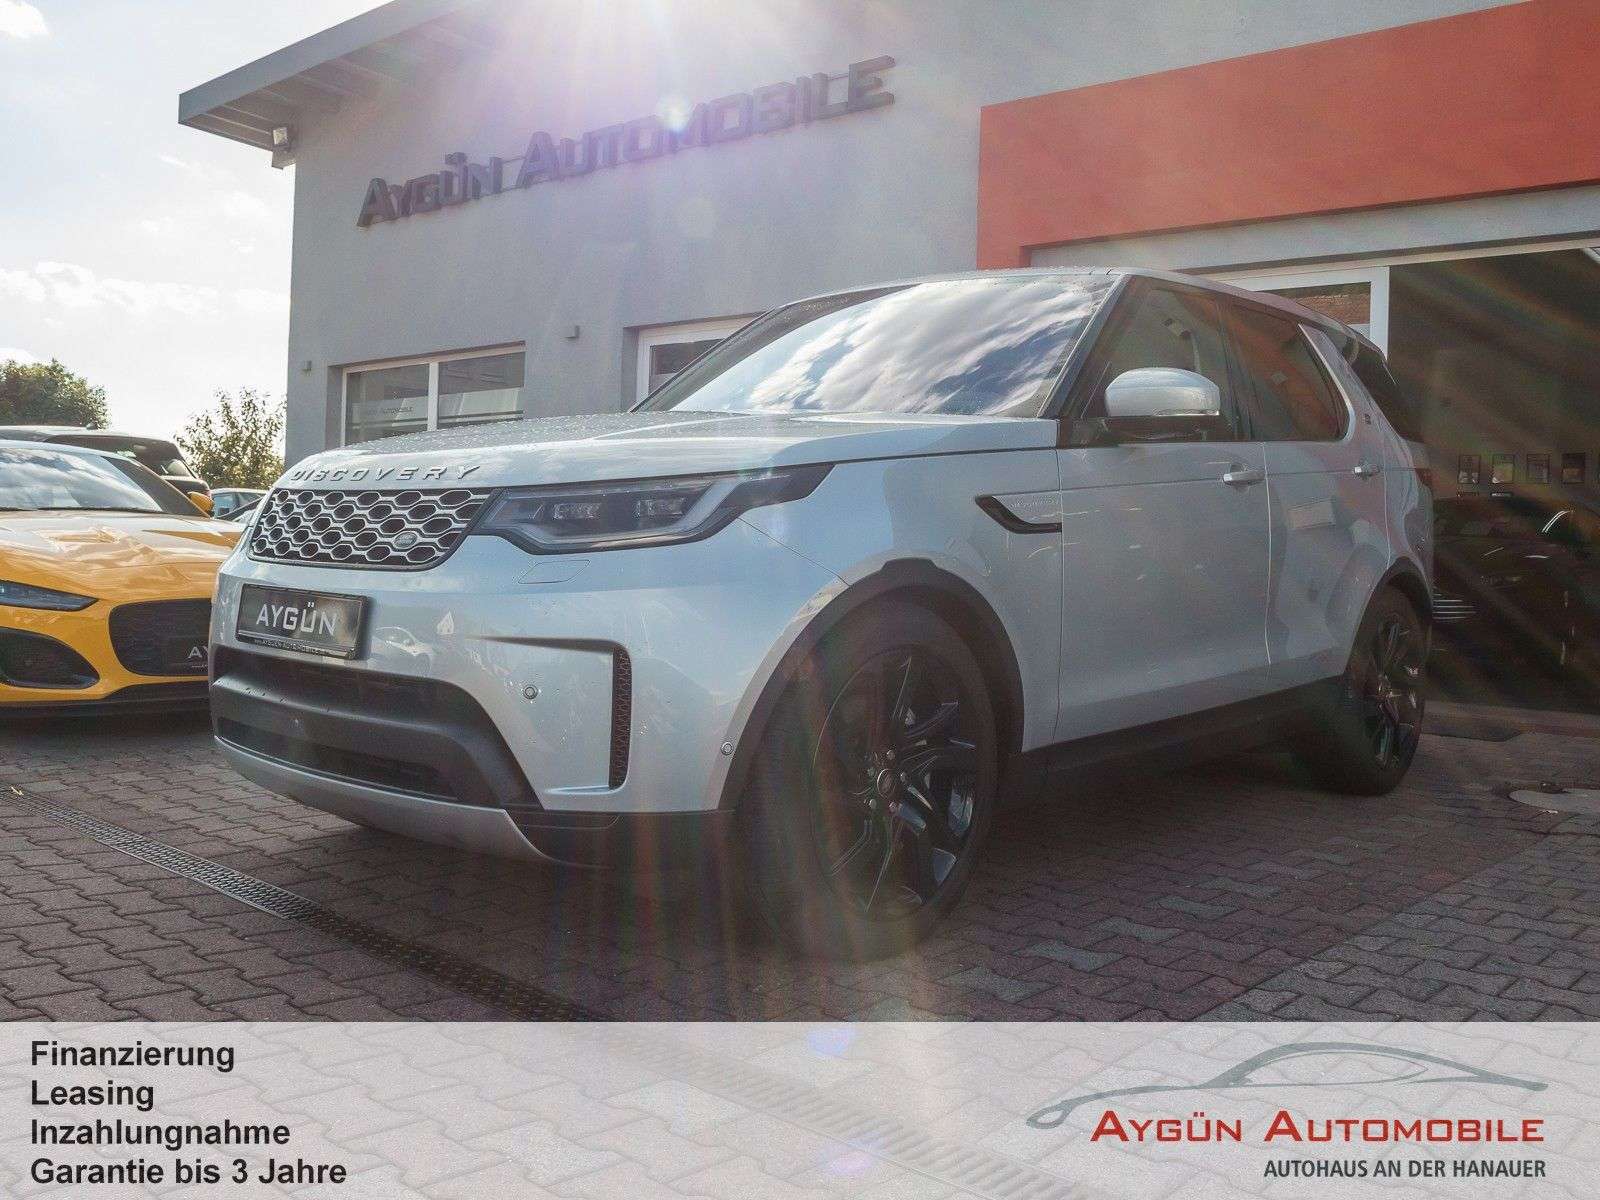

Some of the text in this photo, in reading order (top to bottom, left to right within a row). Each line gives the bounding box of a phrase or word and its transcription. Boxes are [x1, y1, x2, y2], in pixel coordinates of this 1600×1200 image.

[357, 55, 896, 227] AYGÜN AUTOMOBILE
[291, 465, 480, 482] DISCOVERY
[256, 601, 338, 637] AYGÜN
